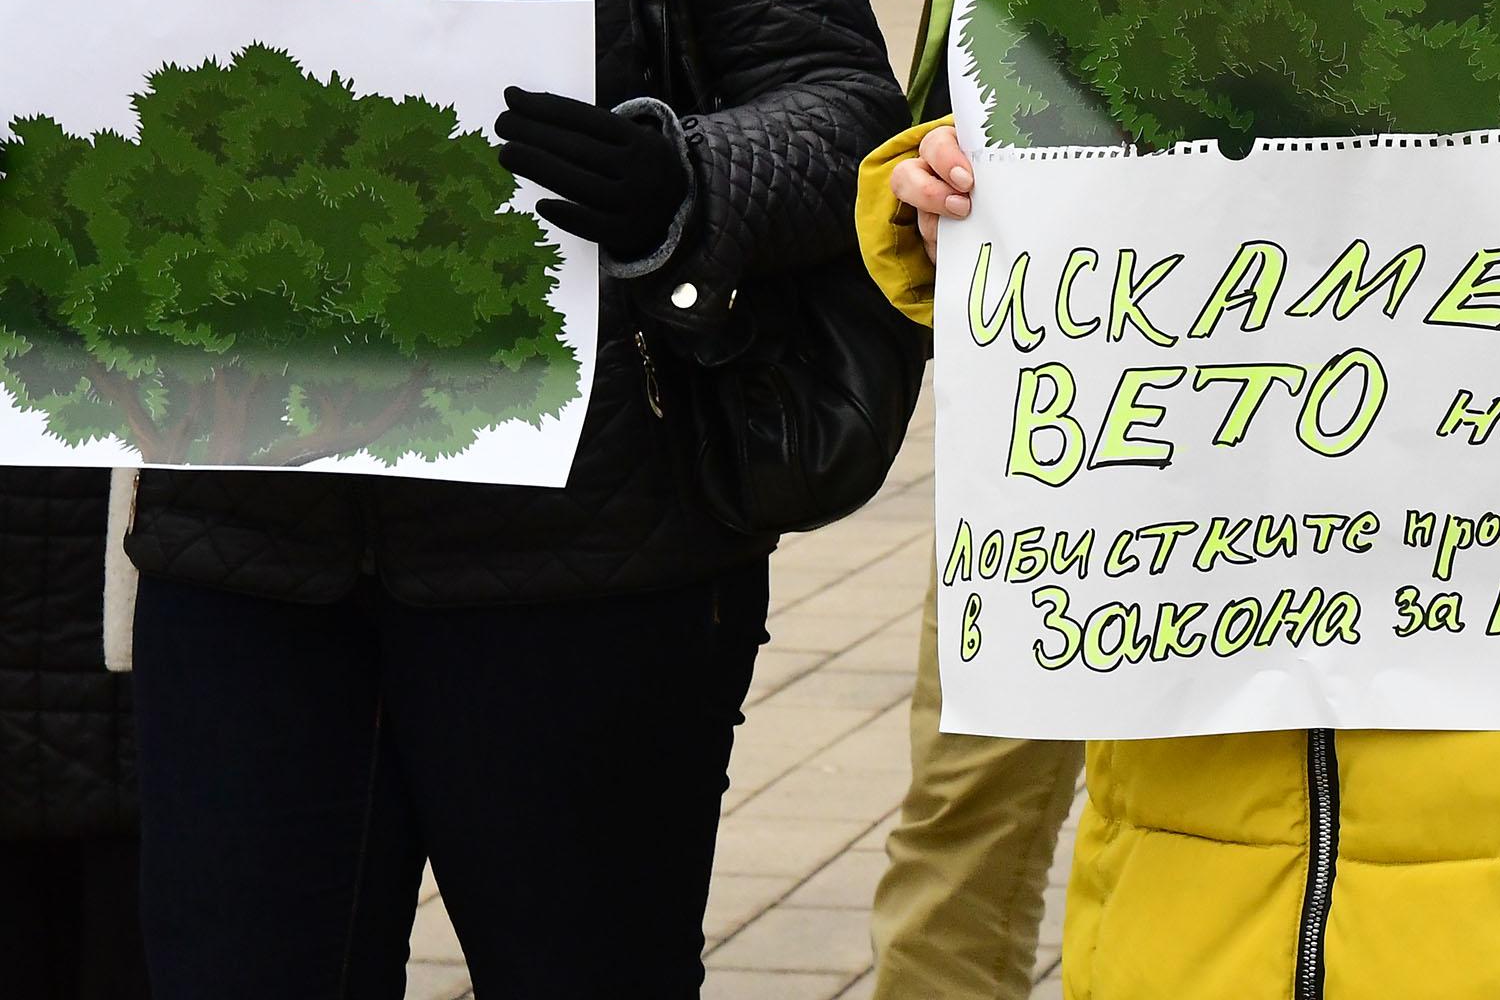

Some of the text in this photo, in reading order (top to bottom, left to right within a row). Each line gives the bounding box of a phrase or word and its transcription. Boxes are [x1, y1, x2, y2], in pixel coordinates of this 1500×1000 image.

[1004, 347, 1389, 488] ВЕТО
[1032, 584, 1361, 672] Закона
[1392, 585, 1466, 637] за
